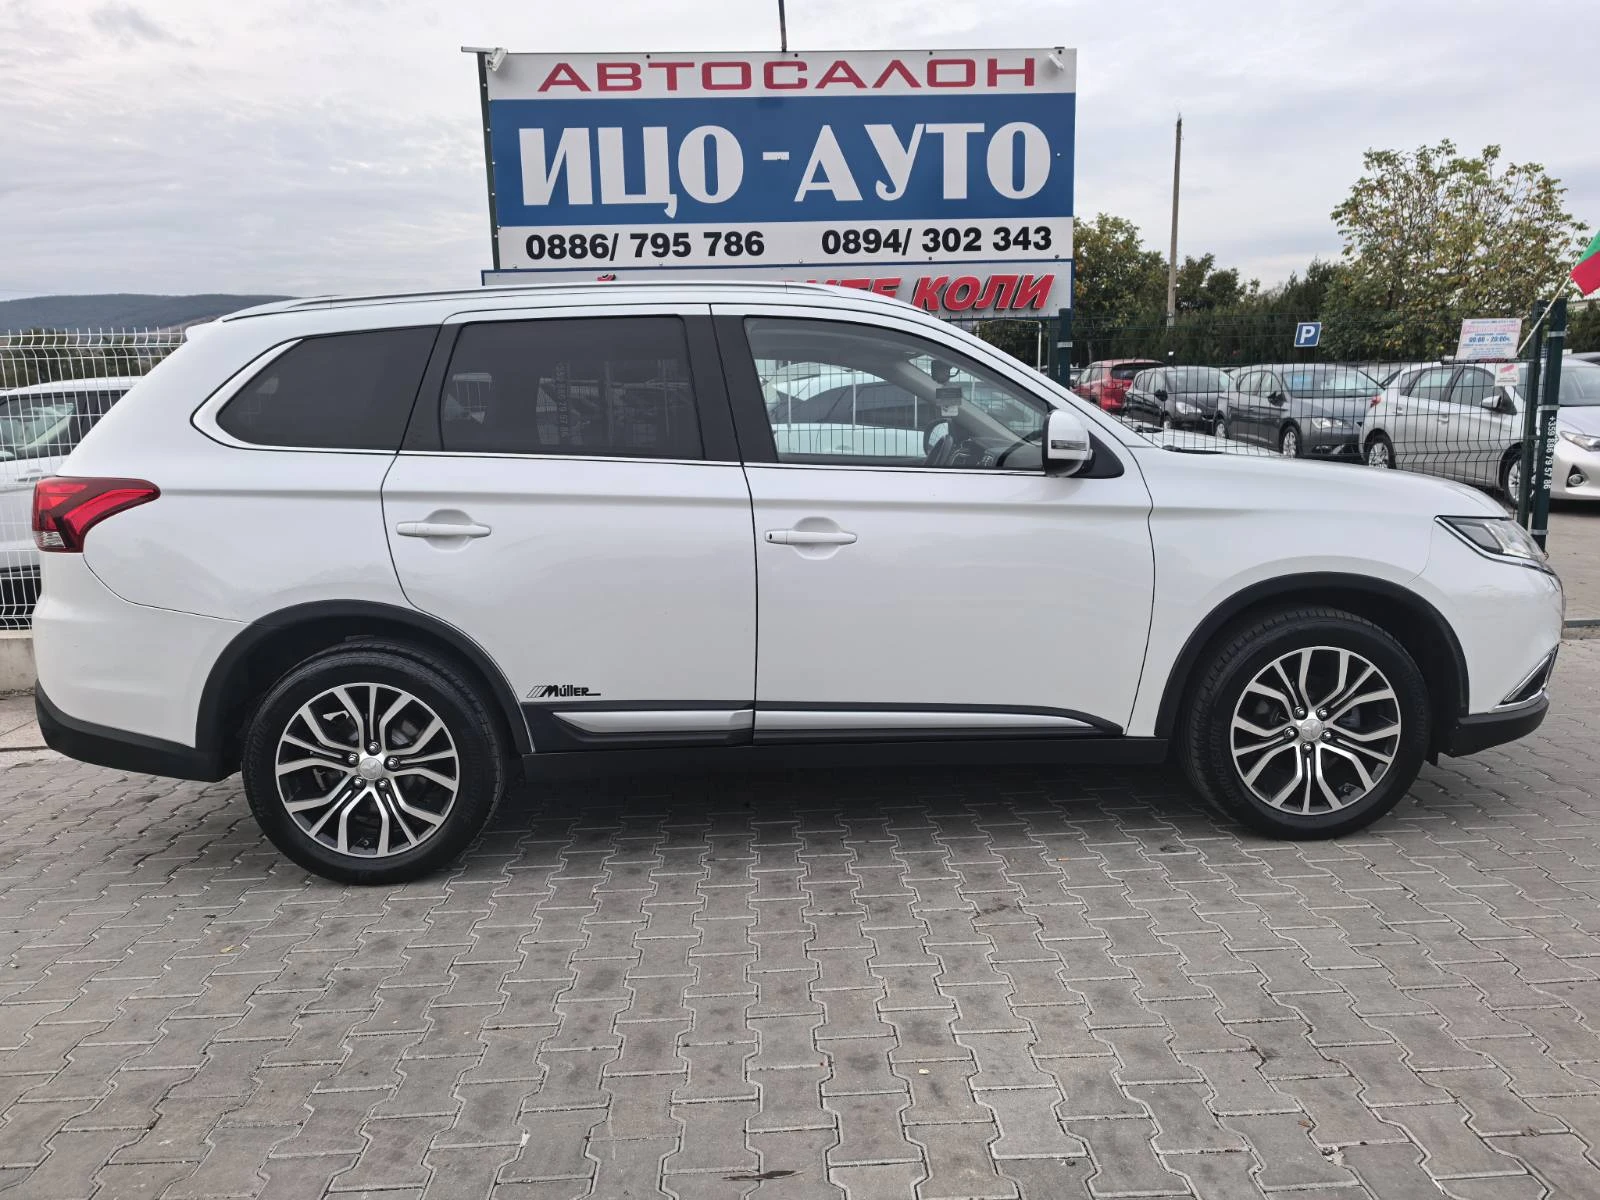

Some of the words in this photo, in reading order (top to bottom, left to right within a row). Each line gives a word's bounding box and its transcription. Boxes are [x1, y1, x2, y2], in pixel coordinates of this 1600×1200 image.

[537, 58, 1036, 93] АВТОСАЛОН
[518, 125, 744, 219] ИЦО
[793, 121, 1051, 202] АУТО
[525, 232, 619, 262] 0886/
[629, 232, 692, 258] 795
[703, 230, 765, 257] 786
[821, 227, 913, 256] 0894/
[921, 226, 982, 253] 302
[992, 225, 1052, 252] 343
[912, 273, 1055, 312] КОЛИ
[1300, 325, 1315, 343] P
